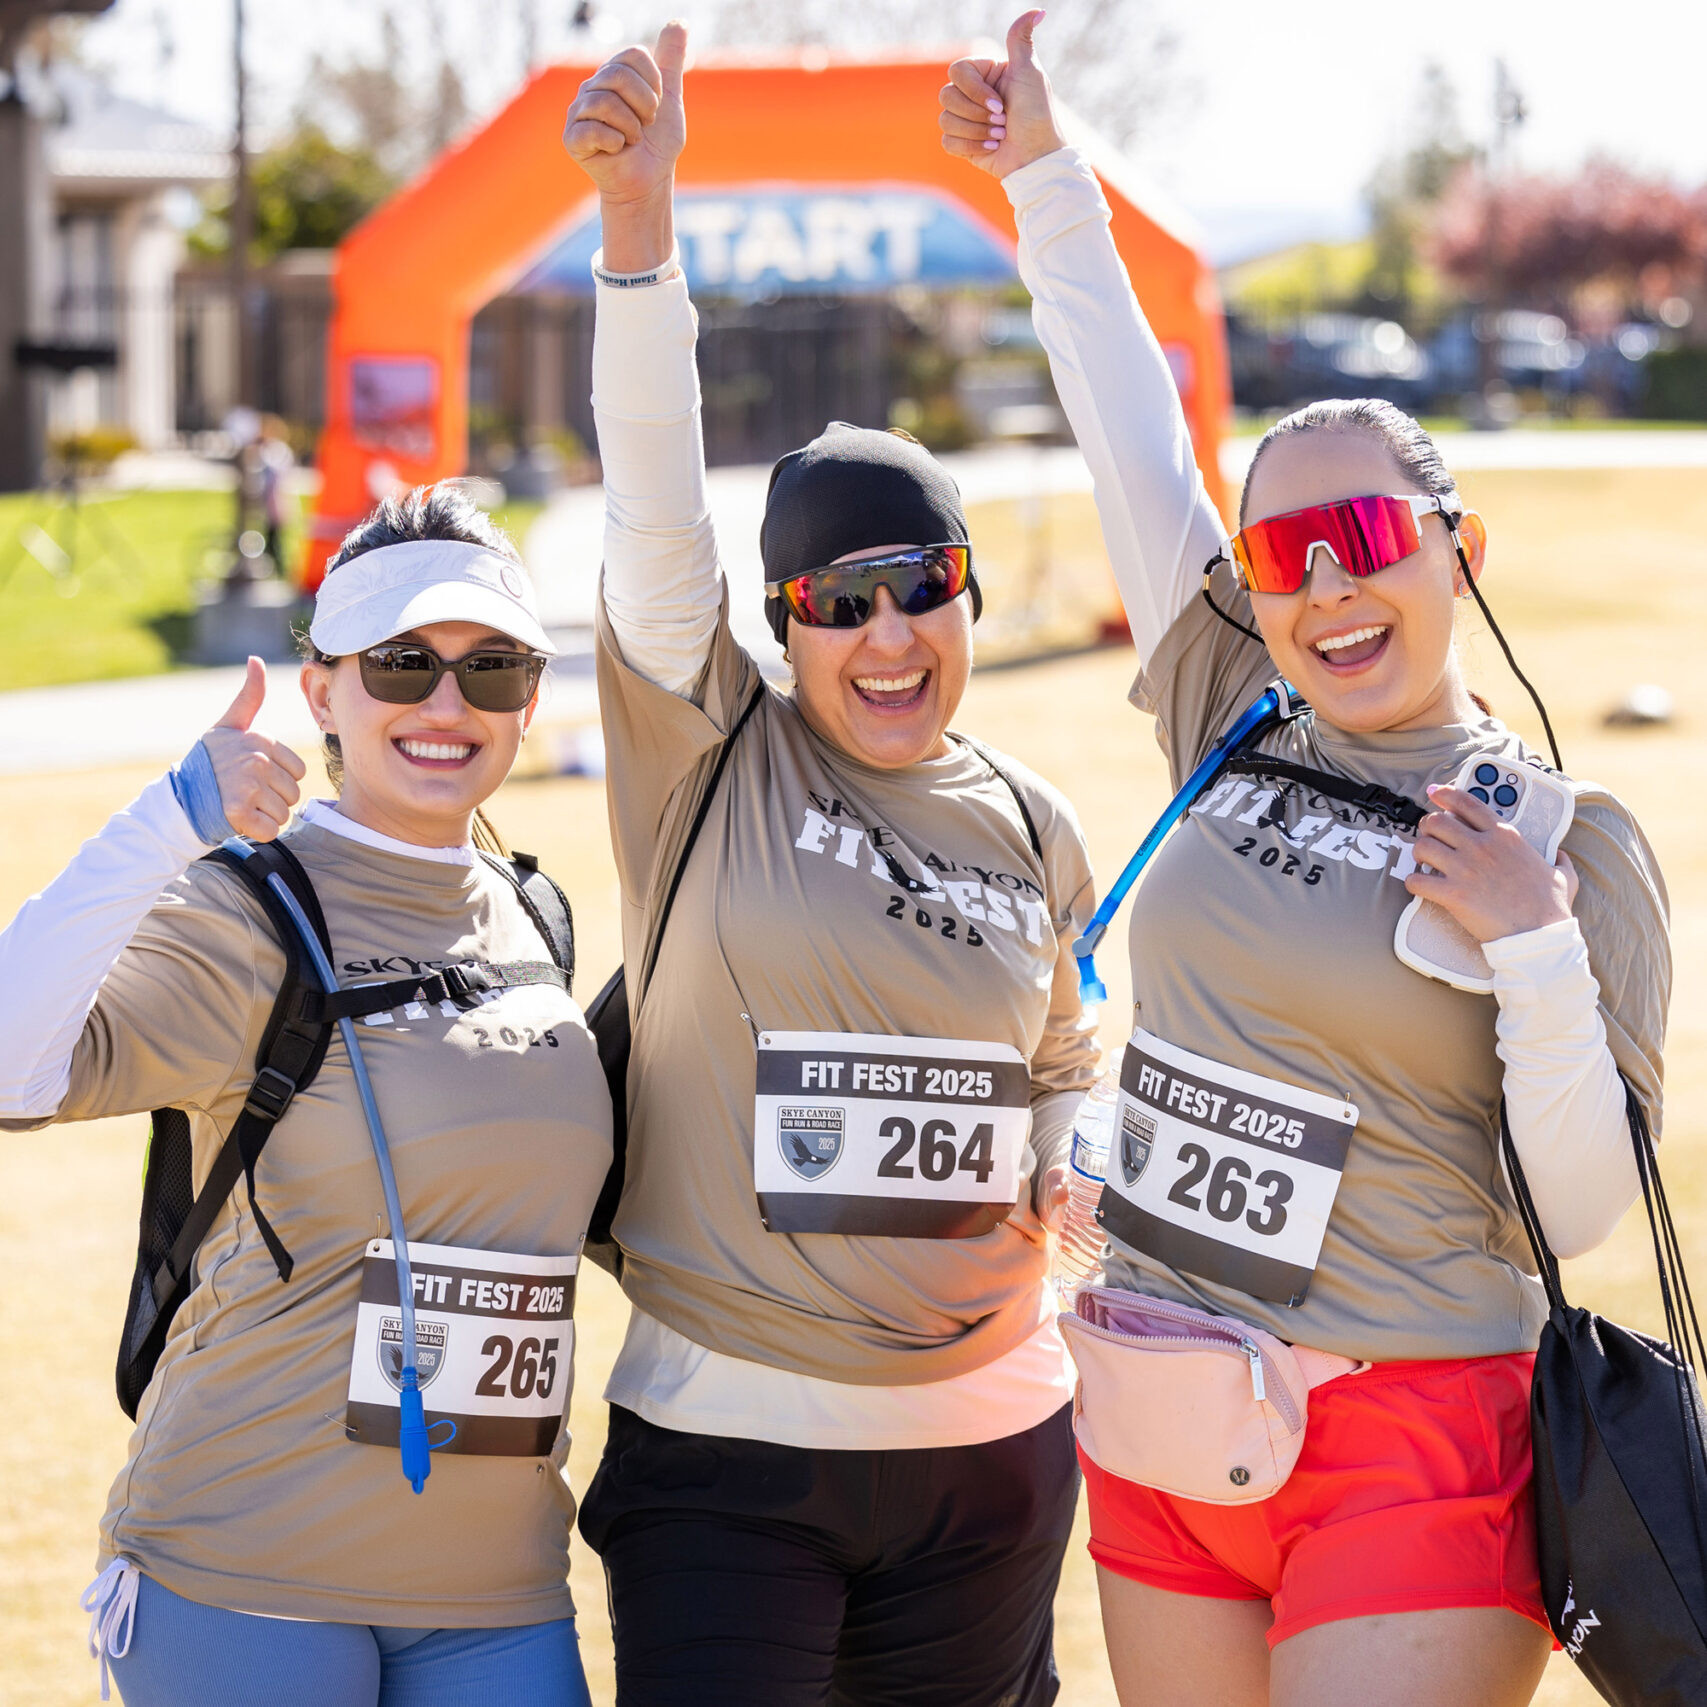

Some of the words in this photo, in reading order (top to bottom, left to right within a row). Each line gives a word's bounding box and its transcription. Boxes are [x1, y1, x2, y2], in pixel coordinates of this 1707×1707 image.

[679, 201, 930, 282] TART
[630, 274, 657, 286] Elani
[1189, 780, 1277, 827] FIT
[1279, 815, 1418, 881] FEST
[1233, 837, 1325, 886] 2025
[886, 896, 984, 946] 2025
[473, 1027, 559, 1048] 2025
[801, 1061, 845, 1089] FIT
[852, 1062, 918, 1093] FEST
[925, 1068, 993, 1098] 2025
[781, 1109, 805, 1117] SKYE
[806, 1109, 842, 1119] CANYON
[782, 1119, 794, 1127] FUN
[794, 1120, 806, 1128] RUN
[806, 1120, 811, 1128] &
[812, 1120, 827, 1128] ROAD
[828, 1121, 841, 1129] RACE
[1138, 1063, 1167, 1100] FIT
[1166, 1077, 1227, 1124] FEST
[1229, 1103, 1306, 1149] 2025
[818, 1138, 835, 1150] 2025
[877, 1116, 994, 1183] 264
[1167, 1142, 1294, 1236] 263
[411, 1272, 452, 1304] FIT
[458, 1278, 524, 1313] FEST
[526, 1286, 565, 1313] 2025
[383, 1319, 402, 1330] SKY
[416, 1323, 445, 1335] ANYON
[416, 1334, 429, 1343] OAD
[429, 1336, 444, 1345] RACE
[417, 1352, 436, 1366] 2025
[475, 1335, 560, 1400] 265
